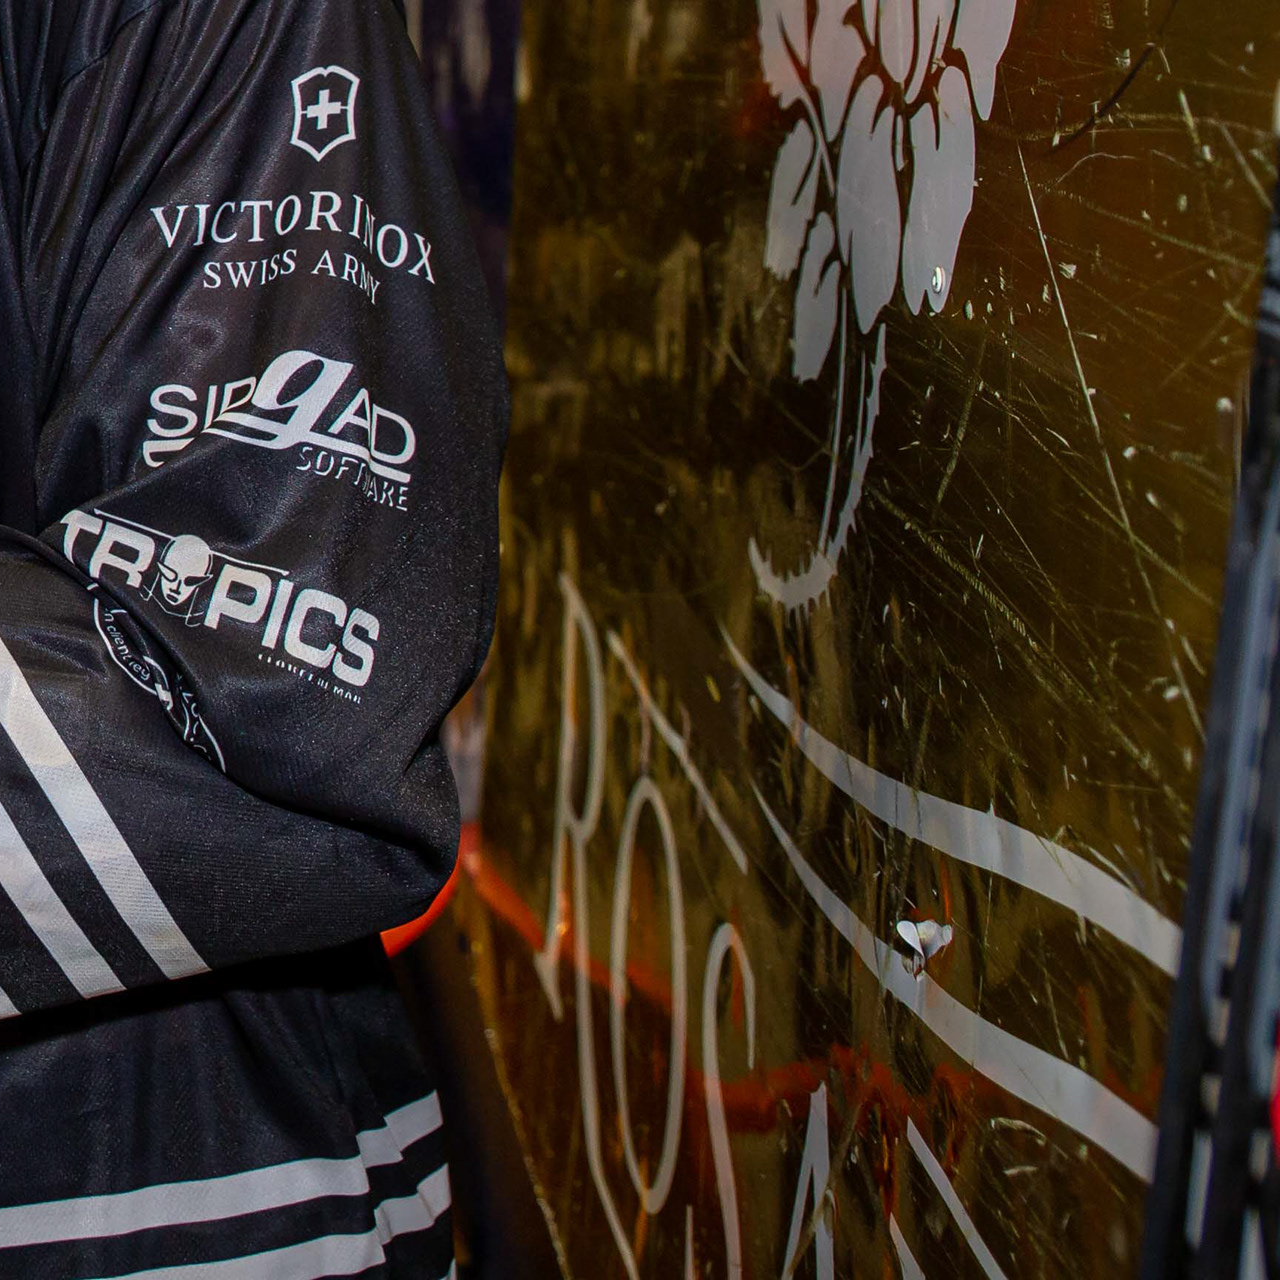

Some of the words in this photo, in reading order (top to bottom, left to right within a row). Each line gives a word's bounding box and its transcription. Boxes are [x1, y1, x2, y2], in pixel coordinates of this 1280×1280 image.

[149, 190, 436, 285] VICTORINOX
[202, 248, 298, 289] SWISS
[310, 249, 381, 305] ARMY
